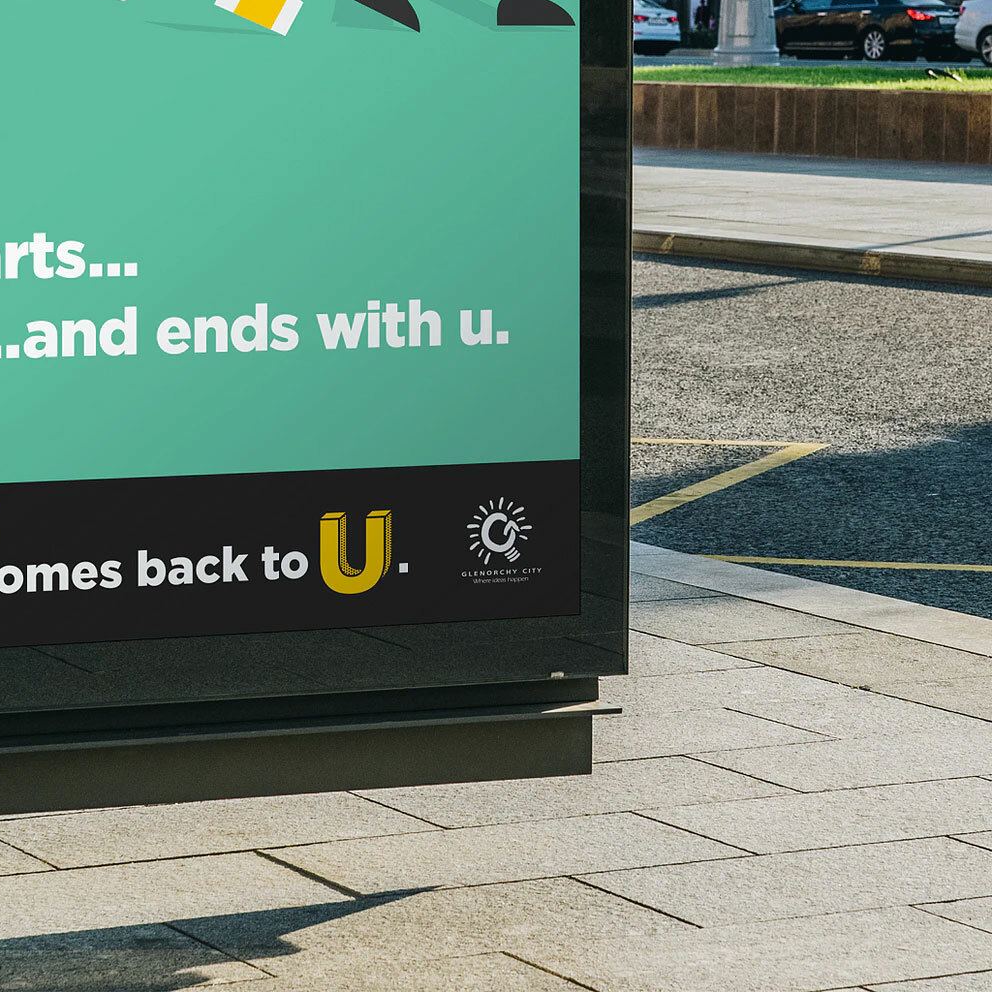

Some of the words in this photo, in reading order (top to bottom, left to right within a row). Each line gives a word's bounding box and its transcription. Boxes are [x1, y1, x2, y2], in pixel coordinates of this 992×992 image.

[156, 303, 299, 355] ends
[315, 299, 442, 352] with
[460, 309, 509, 346] u.
[137, 545, 249, 587] back
[261, 545, 309, 581] to
[461, 569, 518, 578] GLENORCHY
